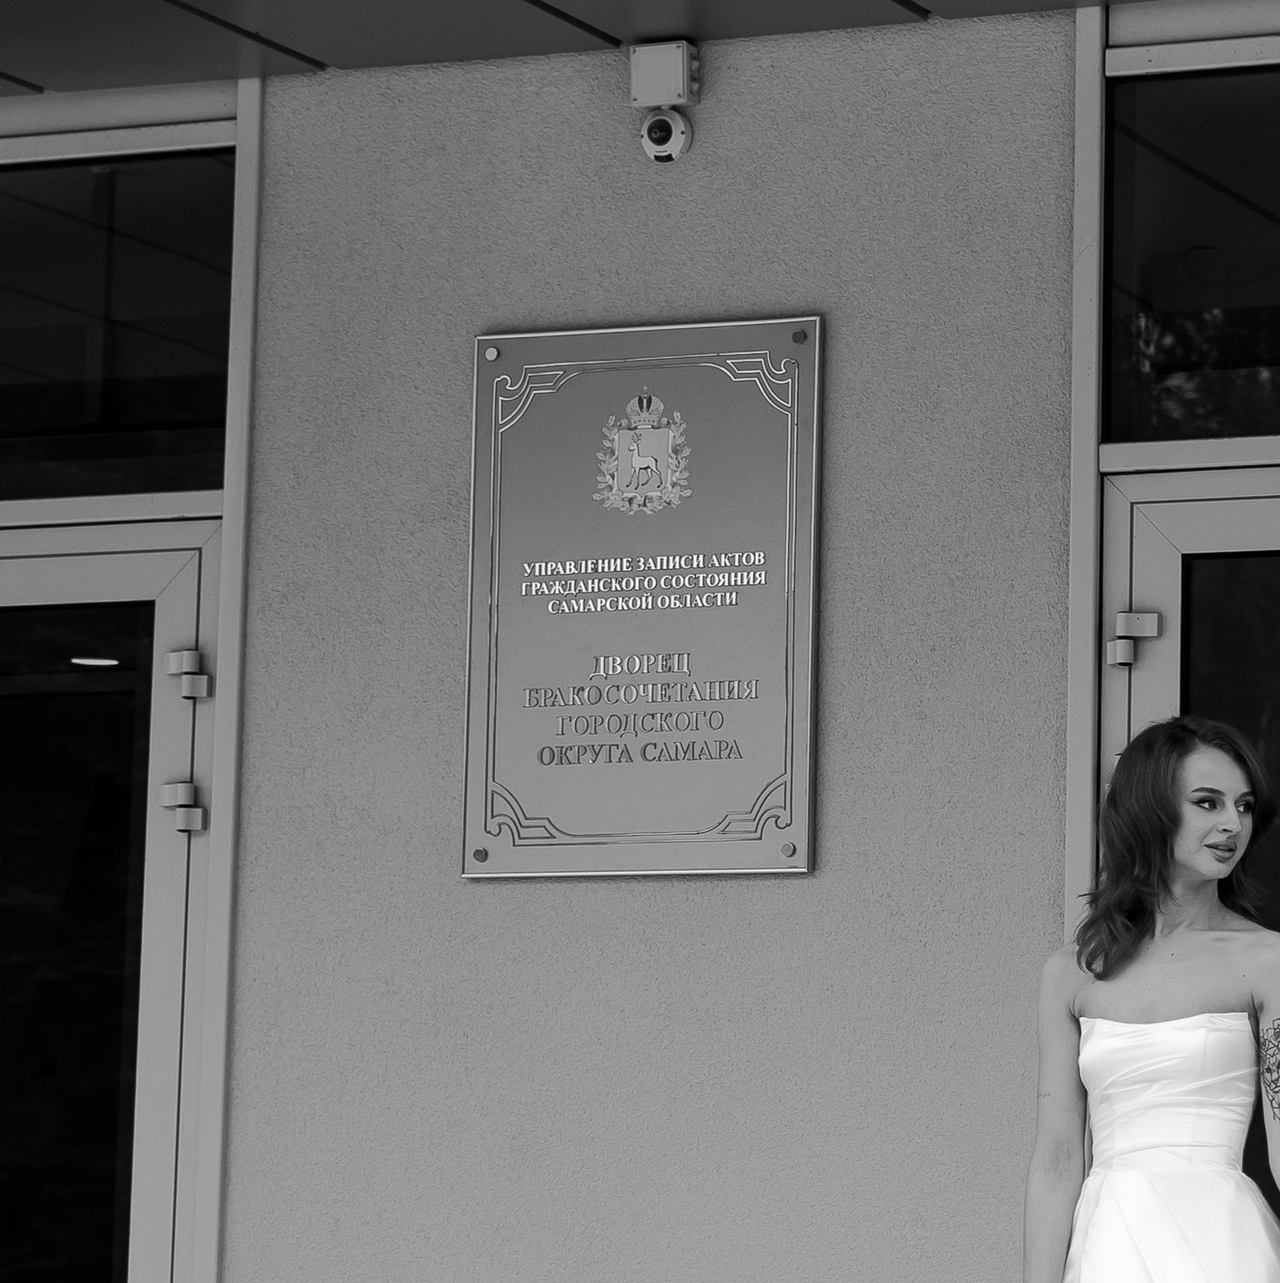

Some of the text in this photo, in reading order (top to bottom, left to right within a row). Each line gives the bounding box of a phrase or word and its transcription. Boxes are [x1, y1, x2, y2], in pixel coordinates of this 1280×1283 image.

[523, 551, 765, 577] УПРАВЛЕНИЕ ЗАПИСИ АКТОВ
[521, 570, 767, 596] ГРАЖДАНСКОГО СОСТОЯНИЯ
[548, 591, 739, 614] САМАРСКОЙ ОБЛАСТИ
[589, 653, 691, 681] ДВОРЕЦ
[522, 679, 759, 708] БРАКОСОЧЕТАНИЯ
[556, 710, 725, 738] ГОРОДСКОГО
[537, 739, 743, 766] ОКРУГА САМАРА
